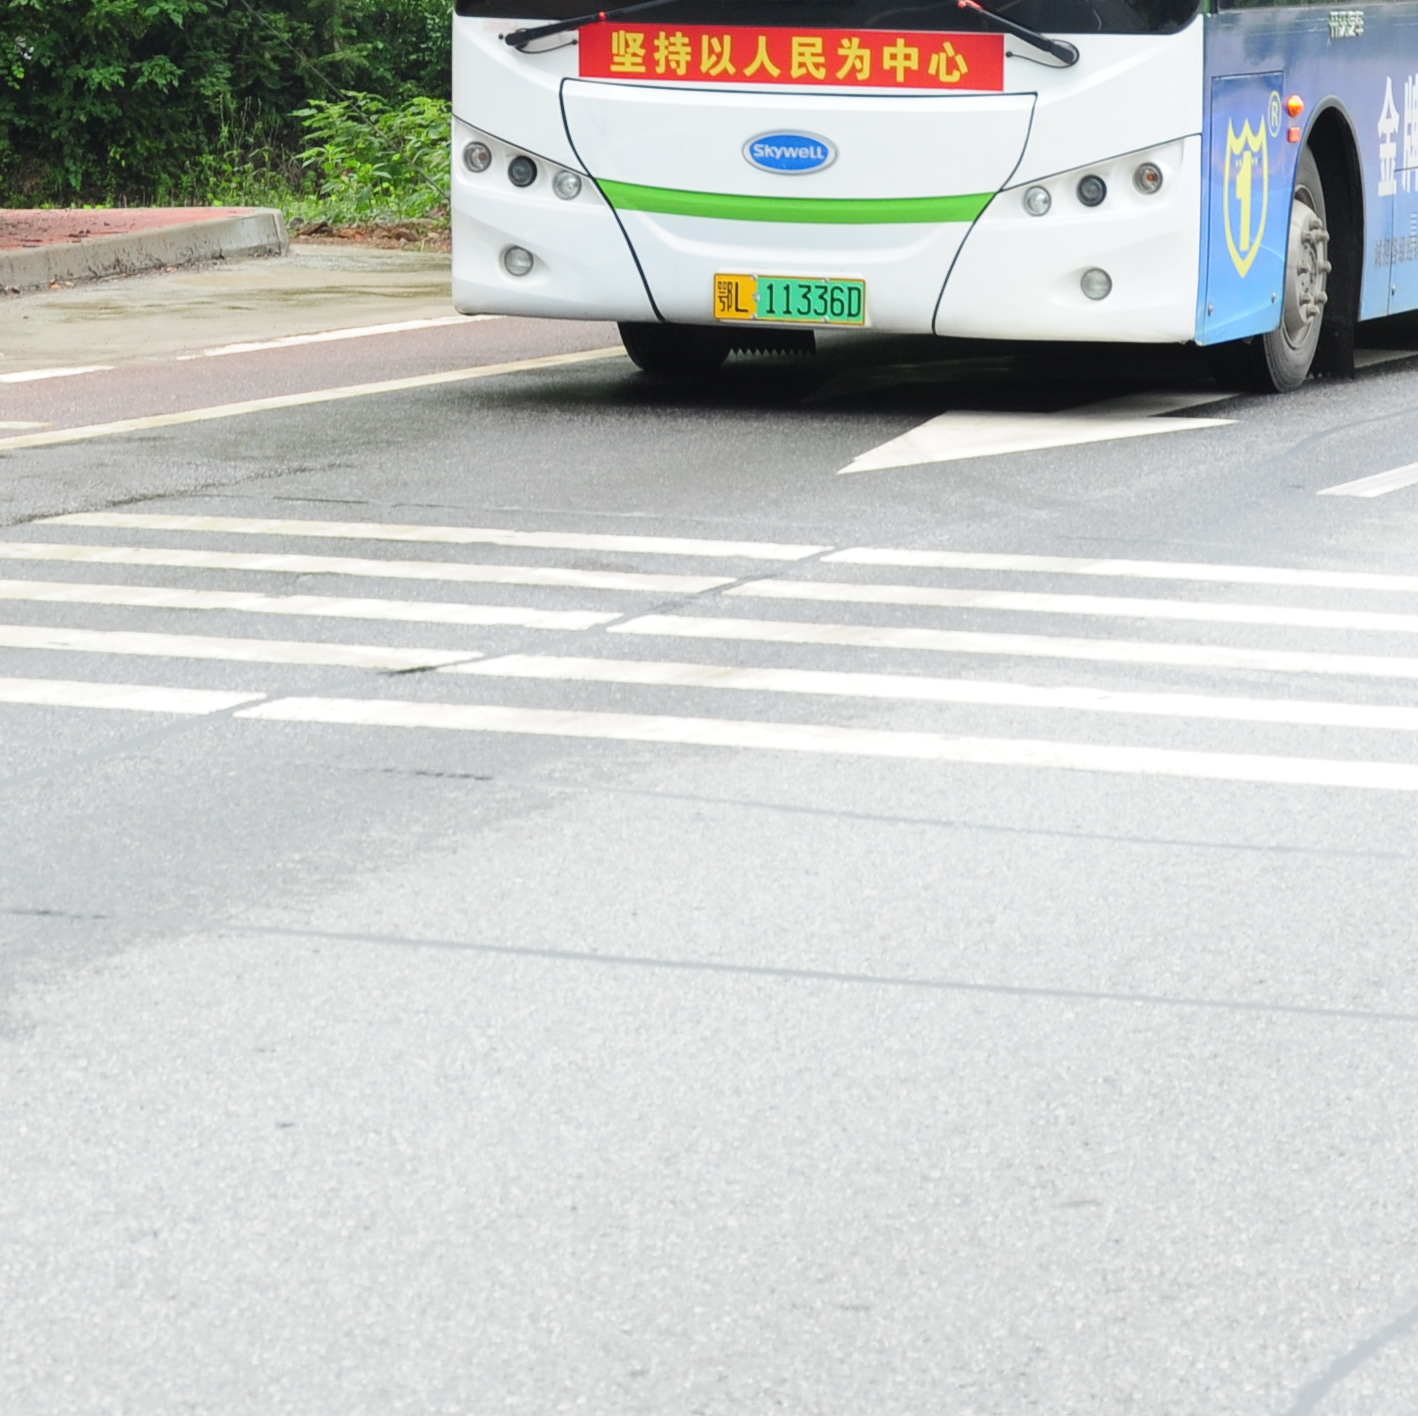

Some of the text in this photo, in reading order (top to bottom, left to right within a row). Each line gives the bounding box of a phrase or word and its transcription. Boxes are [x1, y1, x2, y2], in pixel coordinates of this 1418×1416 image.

[609, 29, 969, 84] 坚持以人民为中心
[753, 143, 825, 160] Skywell
[717, 280, 862, 318] 鄂L 11336D
